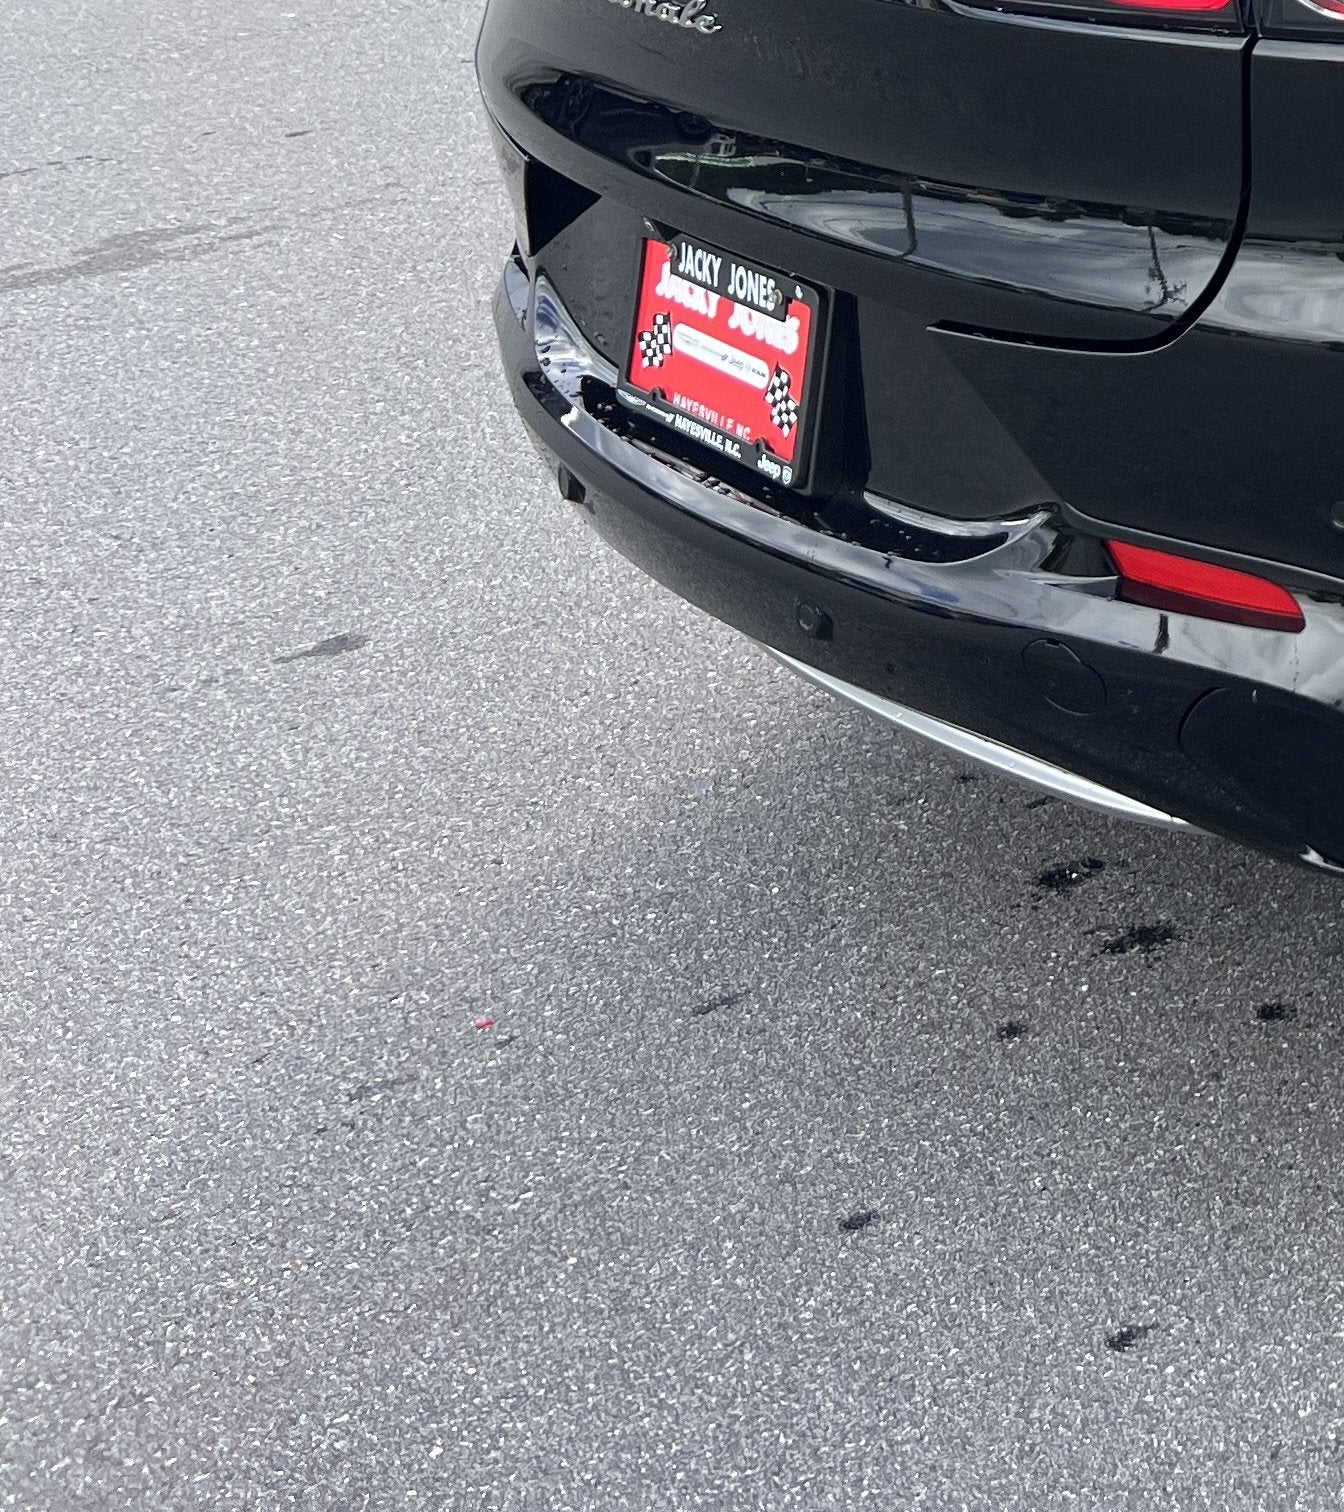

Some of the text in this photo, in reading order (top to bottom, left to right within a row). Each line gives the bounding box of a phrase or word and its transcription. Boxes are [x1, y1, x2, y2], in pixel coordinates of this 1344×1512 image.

[678, 242, 776, 311] JACKY JONES
[757, 454, 781, 480] Jeep
